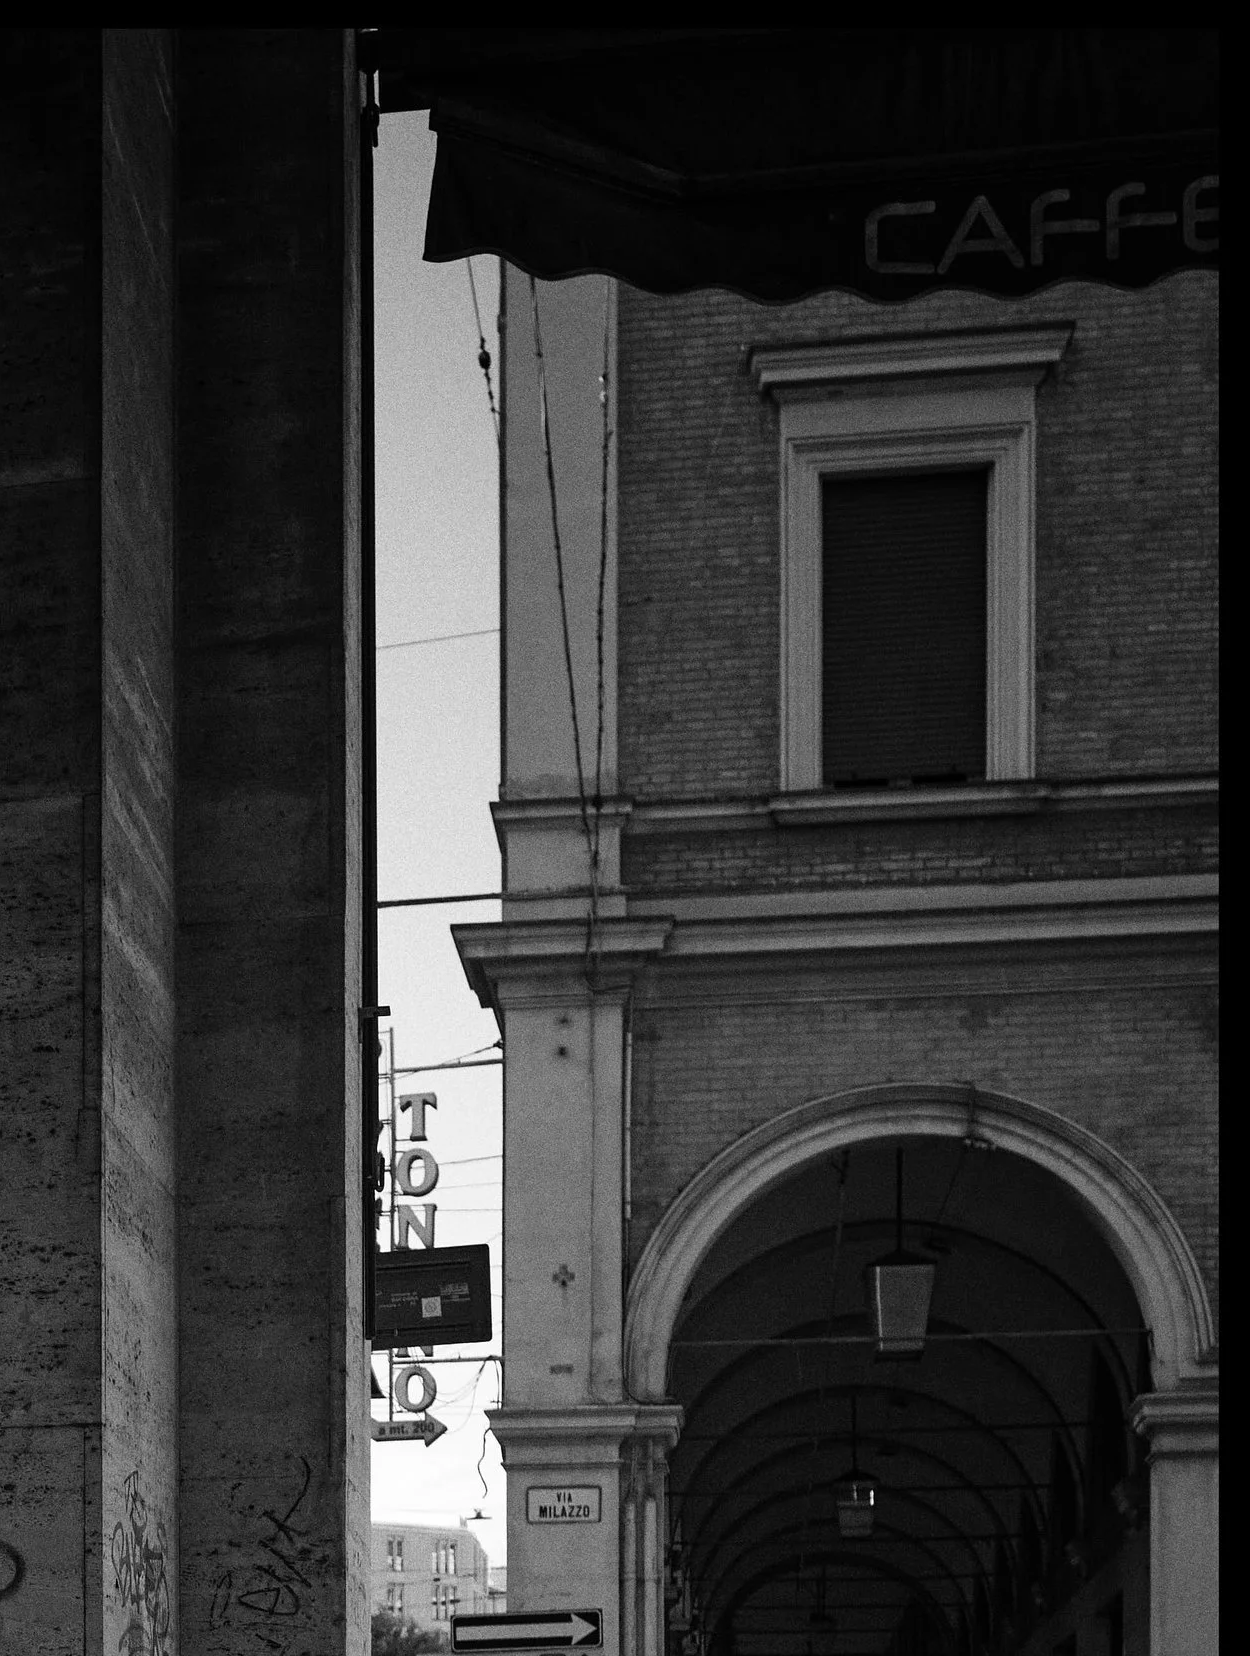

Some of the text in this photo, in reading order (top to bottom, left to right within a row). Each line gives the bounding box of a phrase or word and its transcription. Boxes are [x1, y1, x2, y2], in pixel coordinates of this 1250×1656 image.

[394, 1091, 440, 1413] TONO
[556, 1492, 573, 1504] VIA
[539, 1504, 590, 1519] MILAZZO
